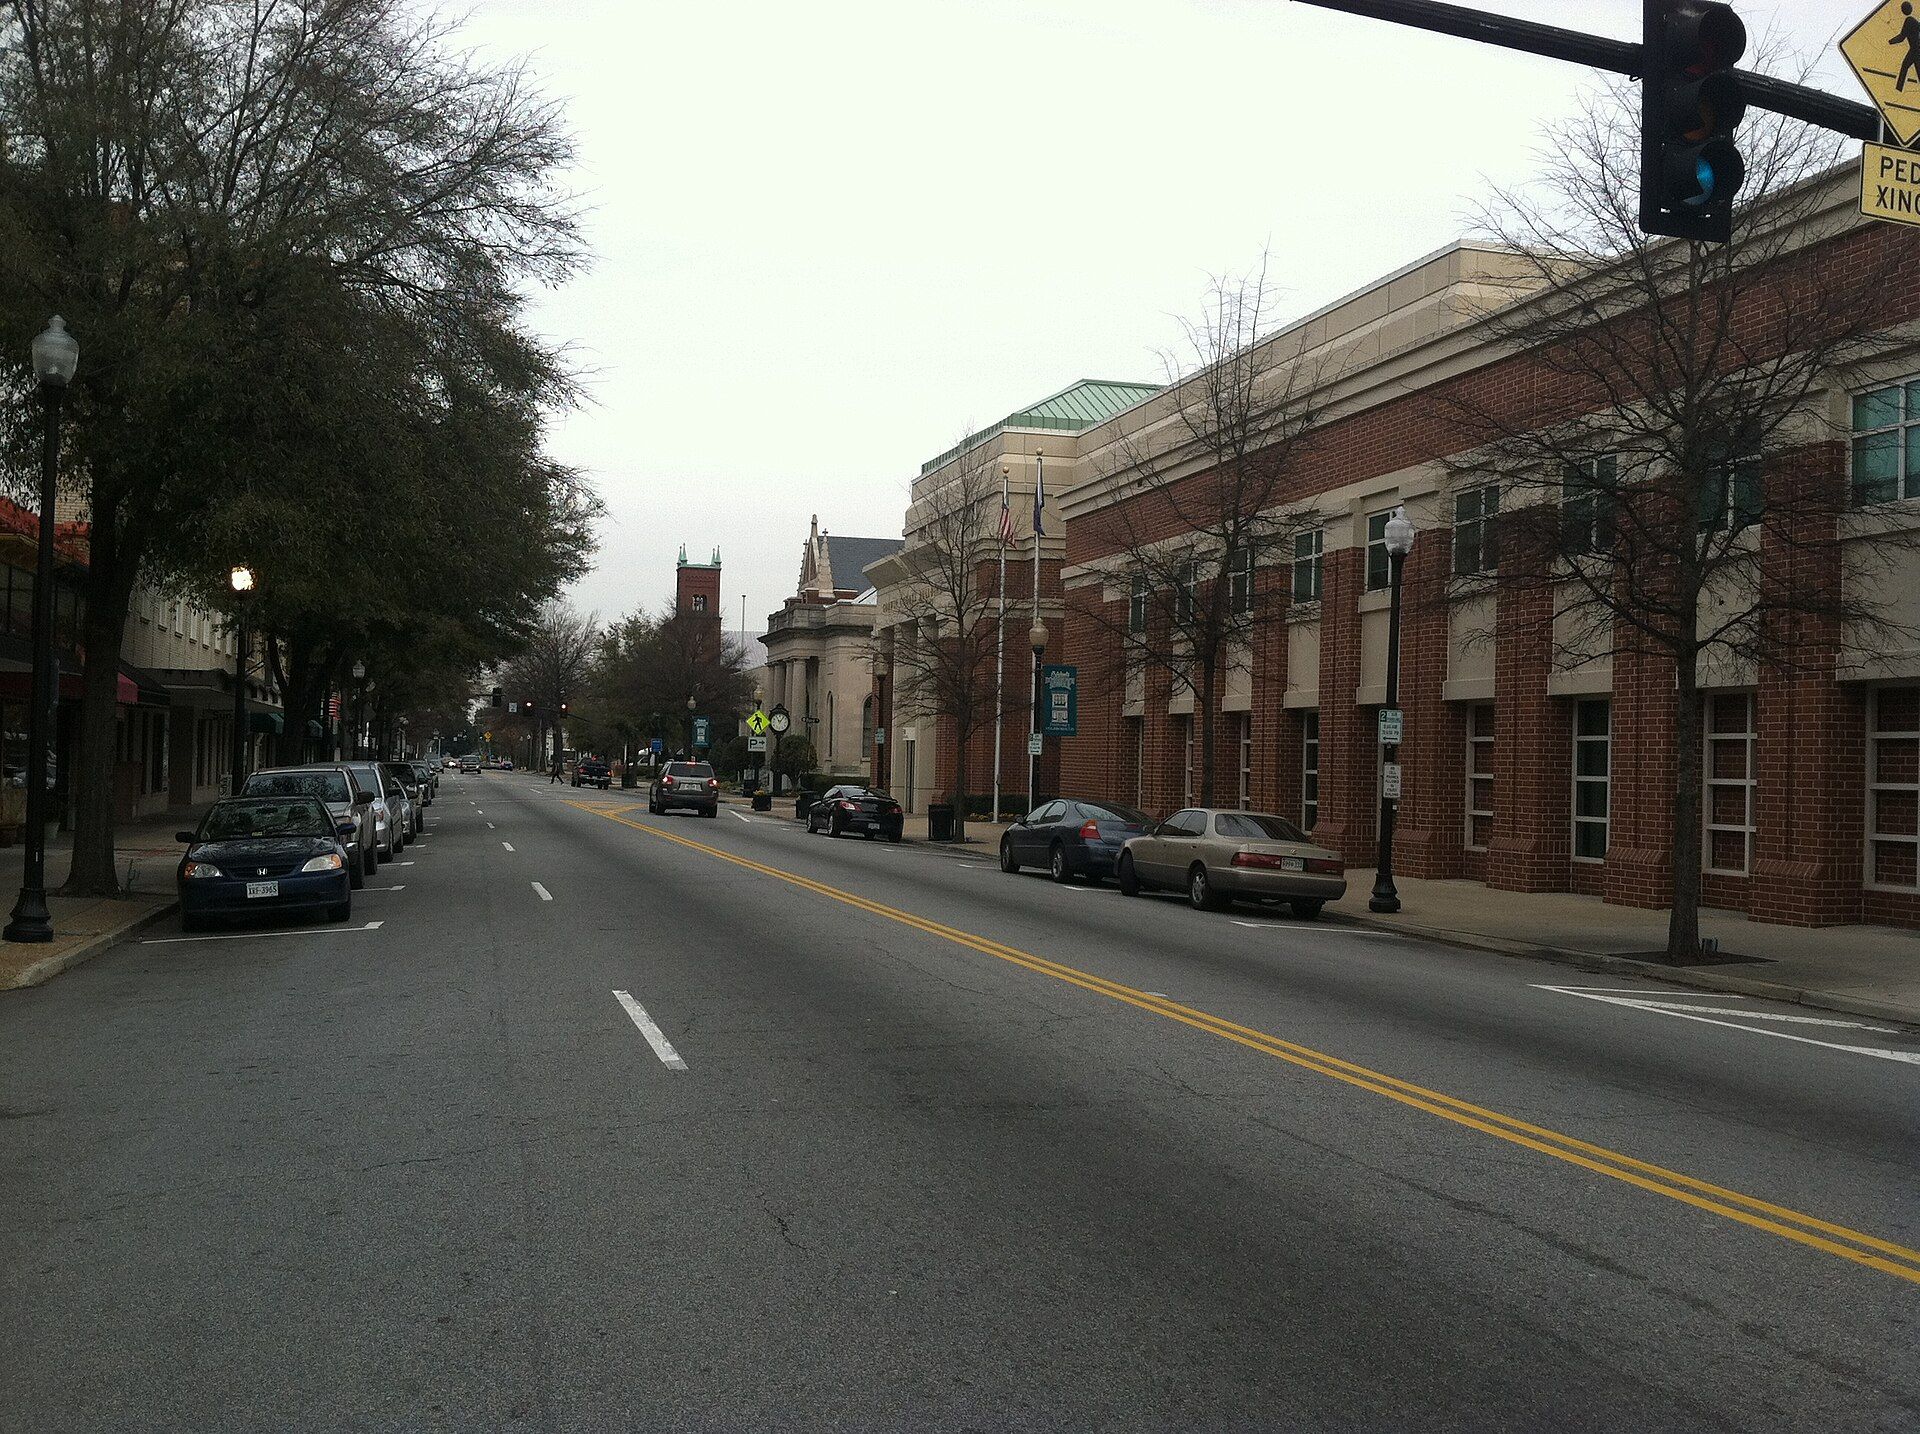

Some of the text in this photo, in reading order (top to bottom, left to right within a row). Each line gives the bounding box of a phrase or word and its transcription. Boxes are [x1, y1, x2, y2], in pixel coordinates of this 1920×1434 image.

[1880, 155, 1920, 185] PED
[1380, 711, 1386, 721] 2
[750, 739, 758, 749] P
